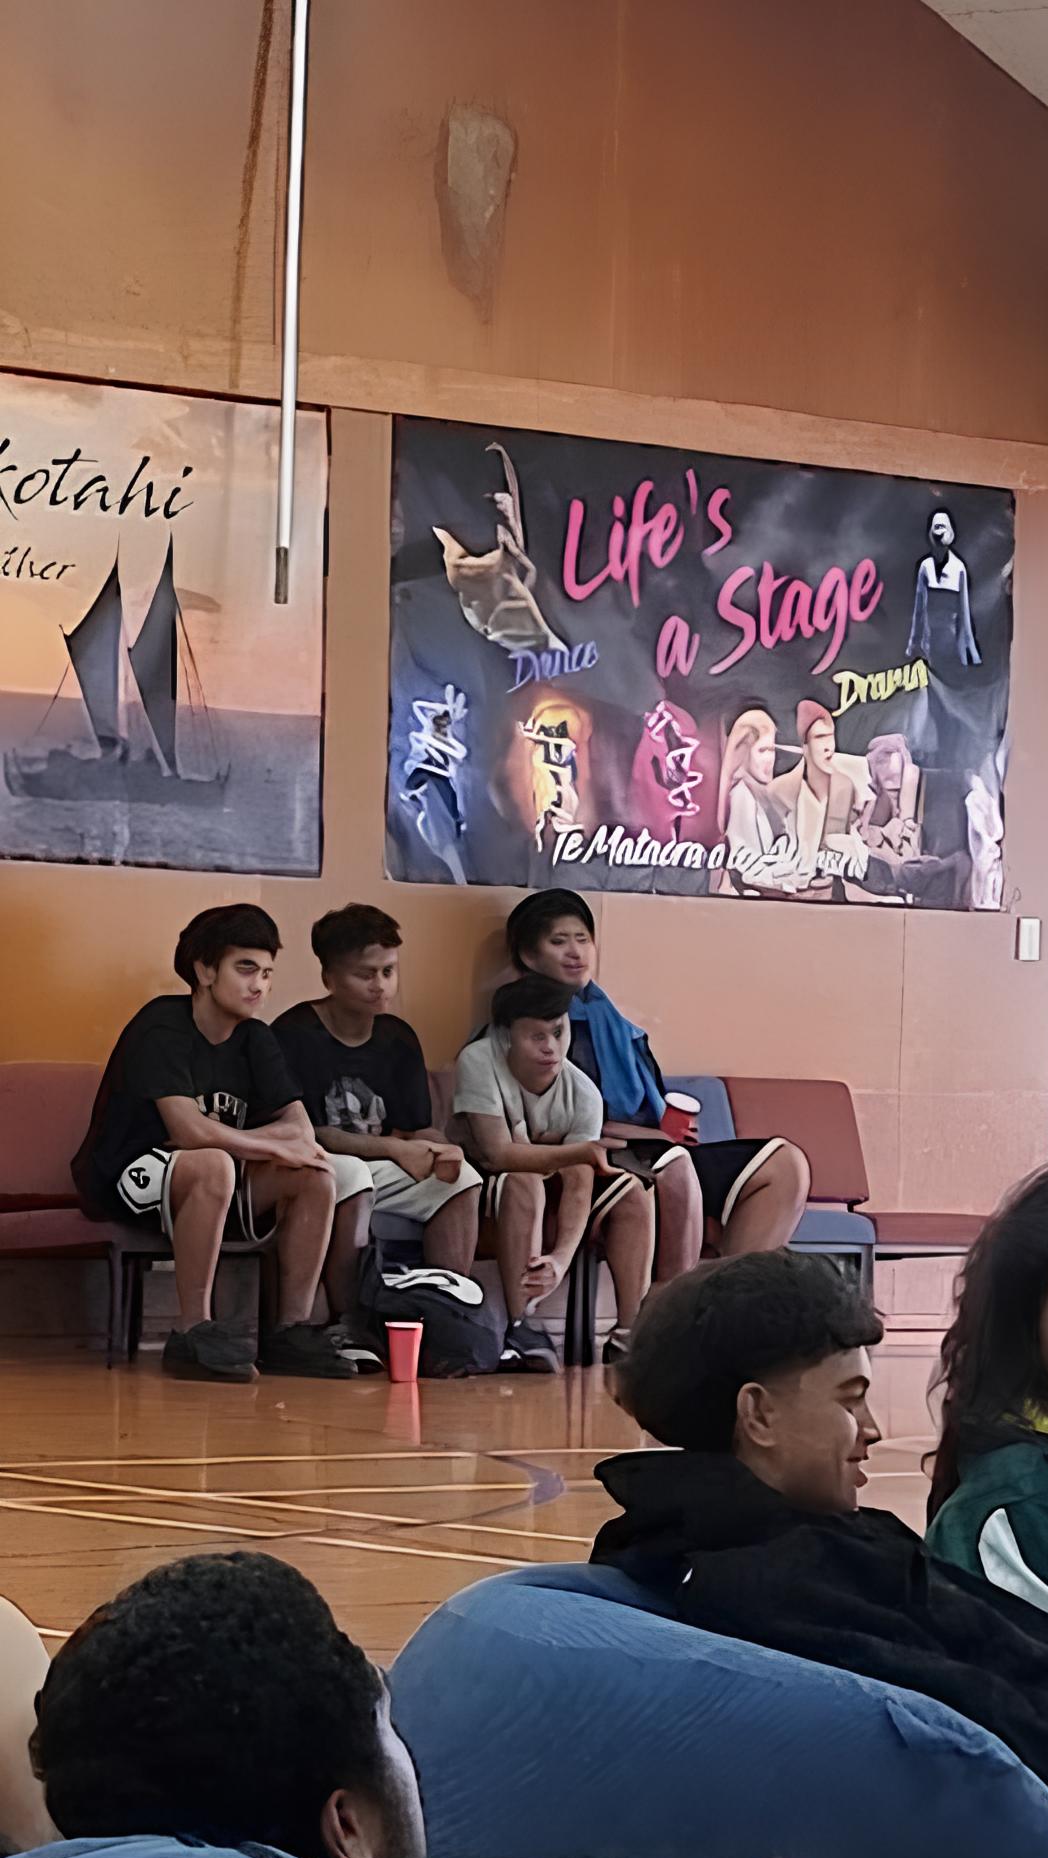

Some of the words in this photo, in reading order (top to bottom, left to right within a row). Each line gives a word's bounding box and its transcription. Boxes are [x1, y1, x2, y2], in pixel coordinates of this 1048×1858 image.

[563, 468, 732, 608] Life's
[656, 615, 700, 679] a
[709, 558, 883, 676] Stage
